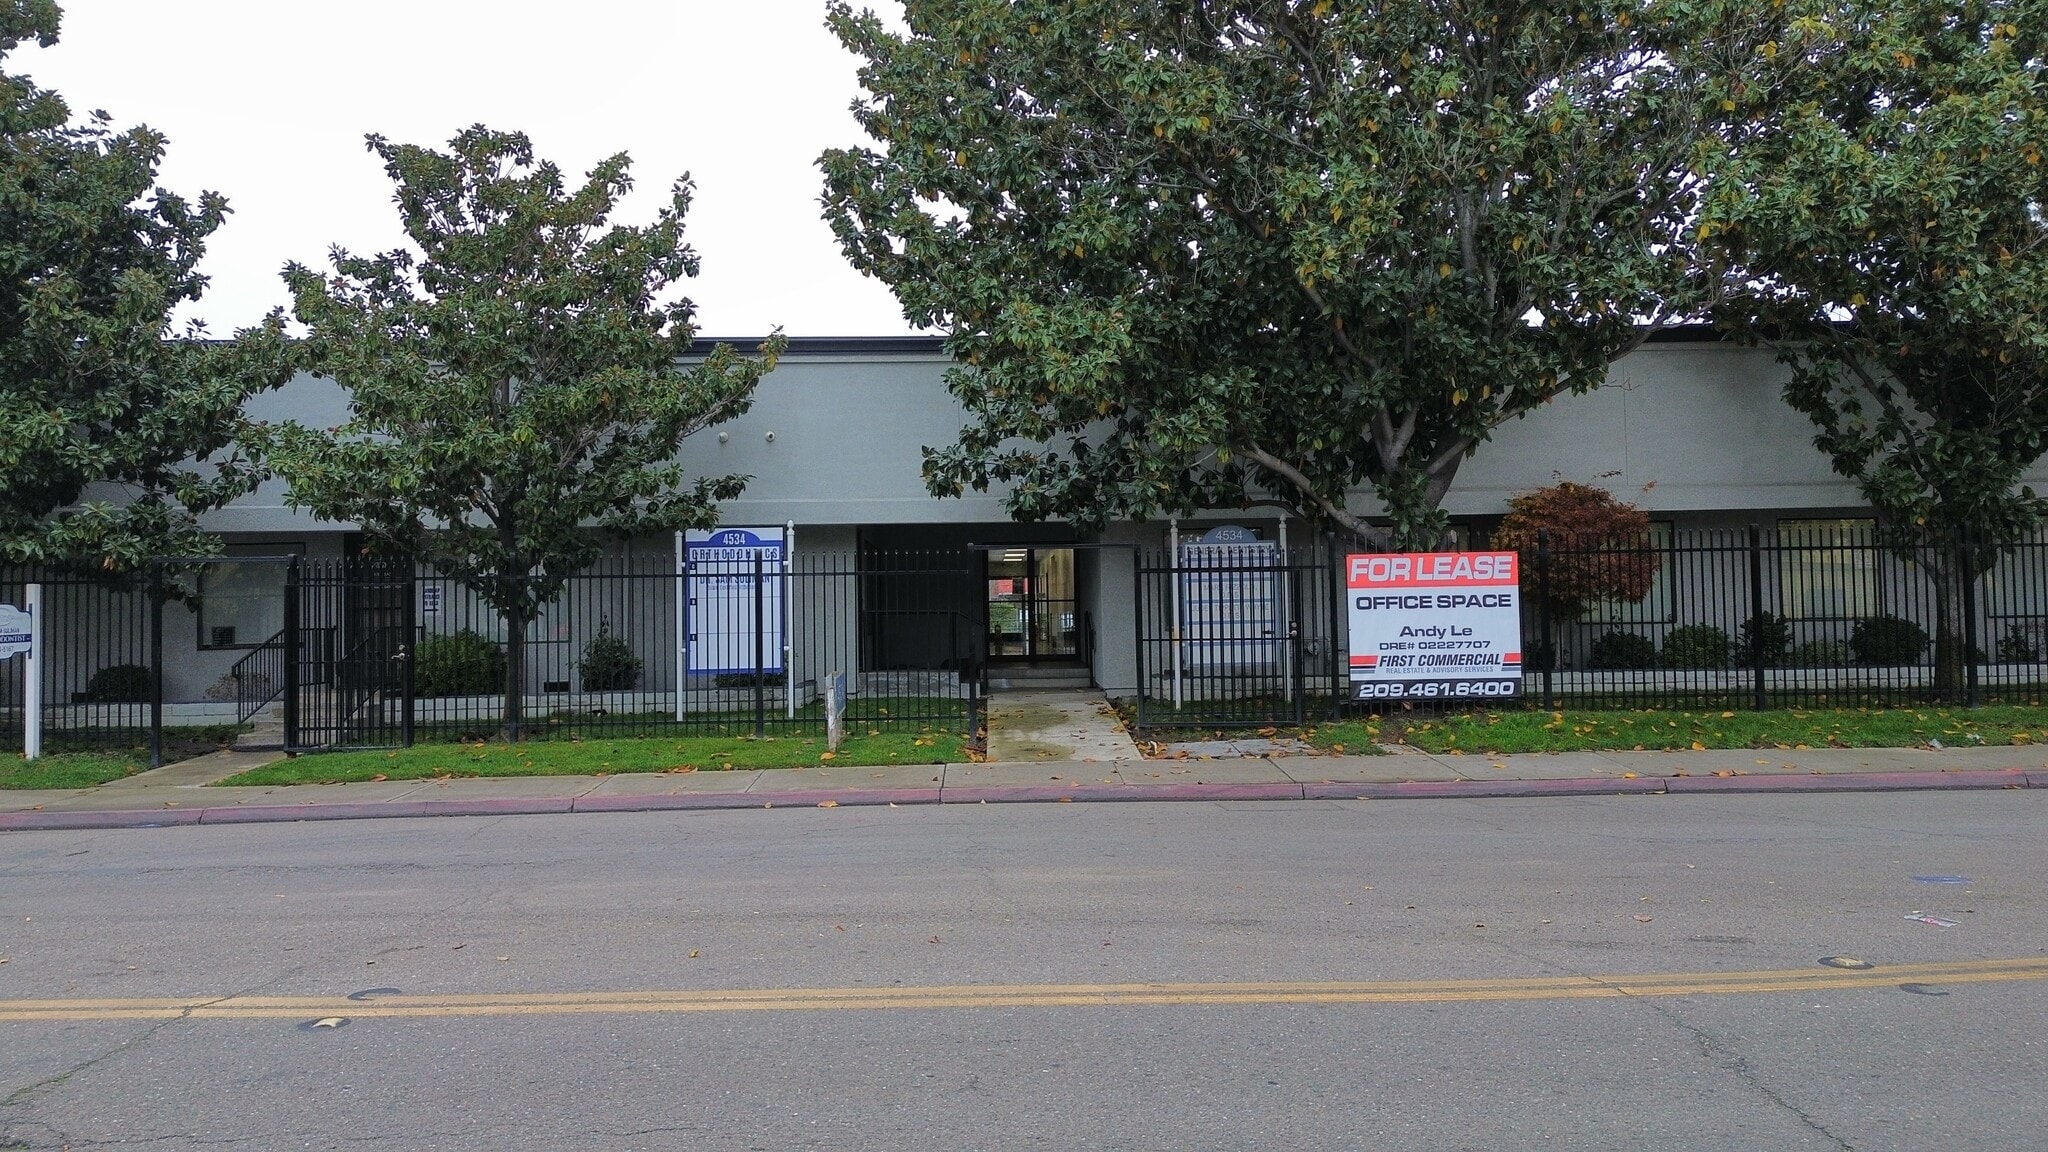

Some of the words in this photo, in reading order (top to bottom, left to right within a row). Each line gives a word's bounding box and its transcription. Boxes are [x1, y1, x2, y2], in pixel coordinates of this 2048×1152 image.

[722, 533, 746, 545] 4534
[1216, 530, 1243, 540] 4534
[692, 548, 778, 560] ORTHODONCS
[1228, 545, 1272, 555] ETSTRY
[1350, 557, 1411, 583] FOR
[1416, 555, 1513, 581] LEASE
[1356, 595, 1433, 610] OFFICE
[1437, 594, 1512, 609] SPACE
[1399, 625, 1446, 639] Andy
[1450, 625, 1473, 636] Le
[1379, 642, 1415, 651] DRE#
[1418, 640, 1491, 650] 02227707
[1379, 655, 1415, 667] FIRST
[1418, 653, 1501, 667] COMMERCIAL
[1359, 681, 1515, 698] 209.461.6400
